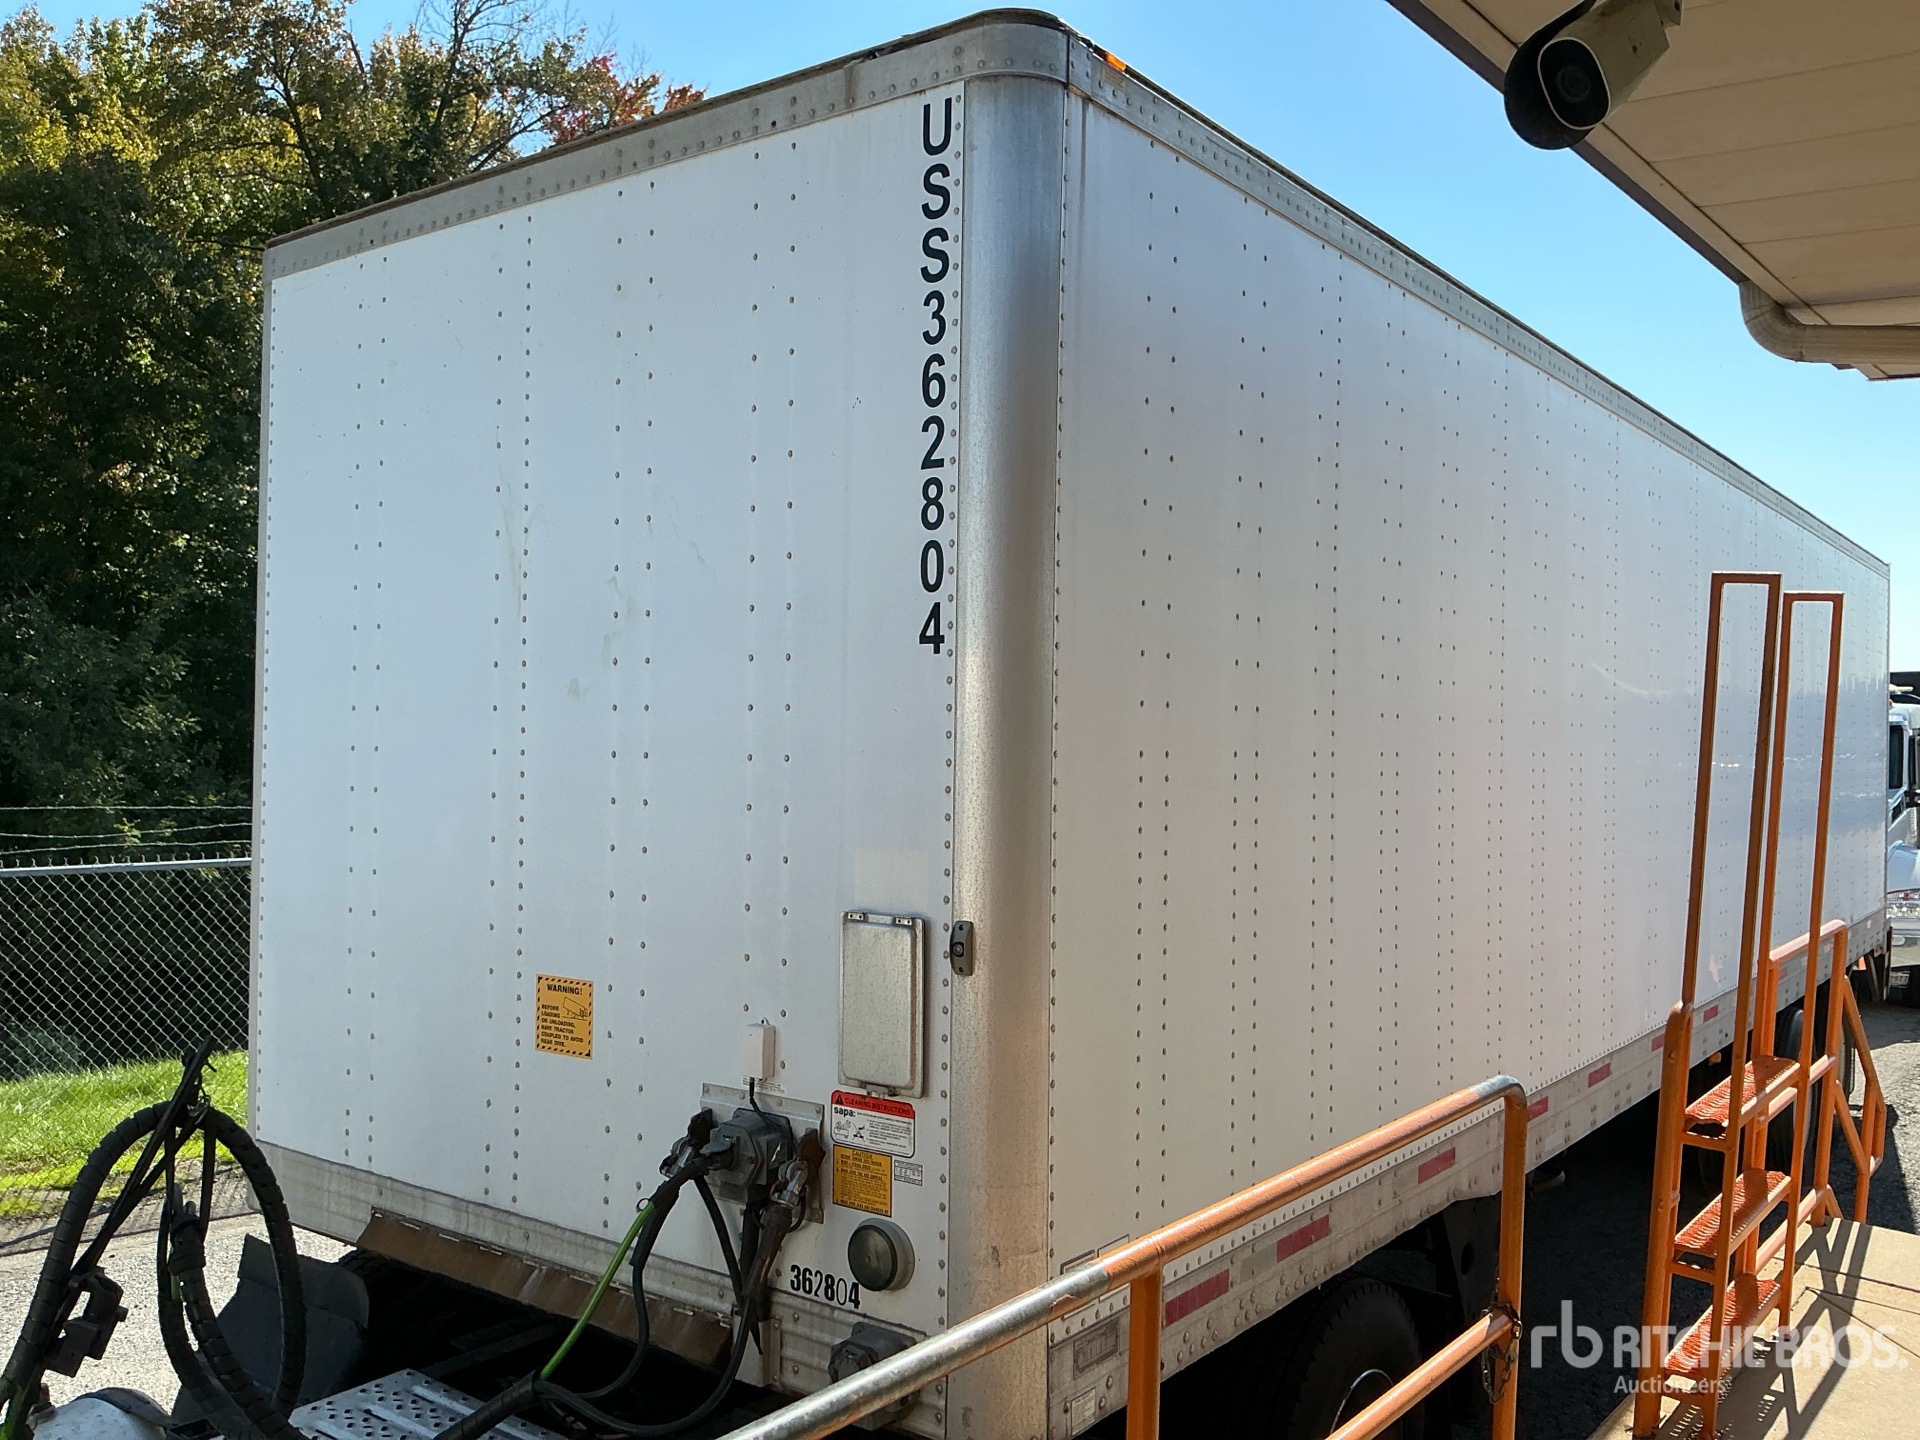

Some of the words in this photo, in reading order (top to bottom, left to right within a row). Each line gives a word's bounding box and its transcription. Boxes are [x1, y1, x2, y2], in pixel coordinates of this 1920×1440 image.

[918, 96, 952, 655] USS362804
[547, 983, 583, 995] WARNING!
[541, 1031, 562, 1039] COUPLED
[844, 1097, 871, 1109] CLEANING
[871, 1101, 911, 1116] INSTRUCTIONS
[790, 1264, 861, 1310] 362804
